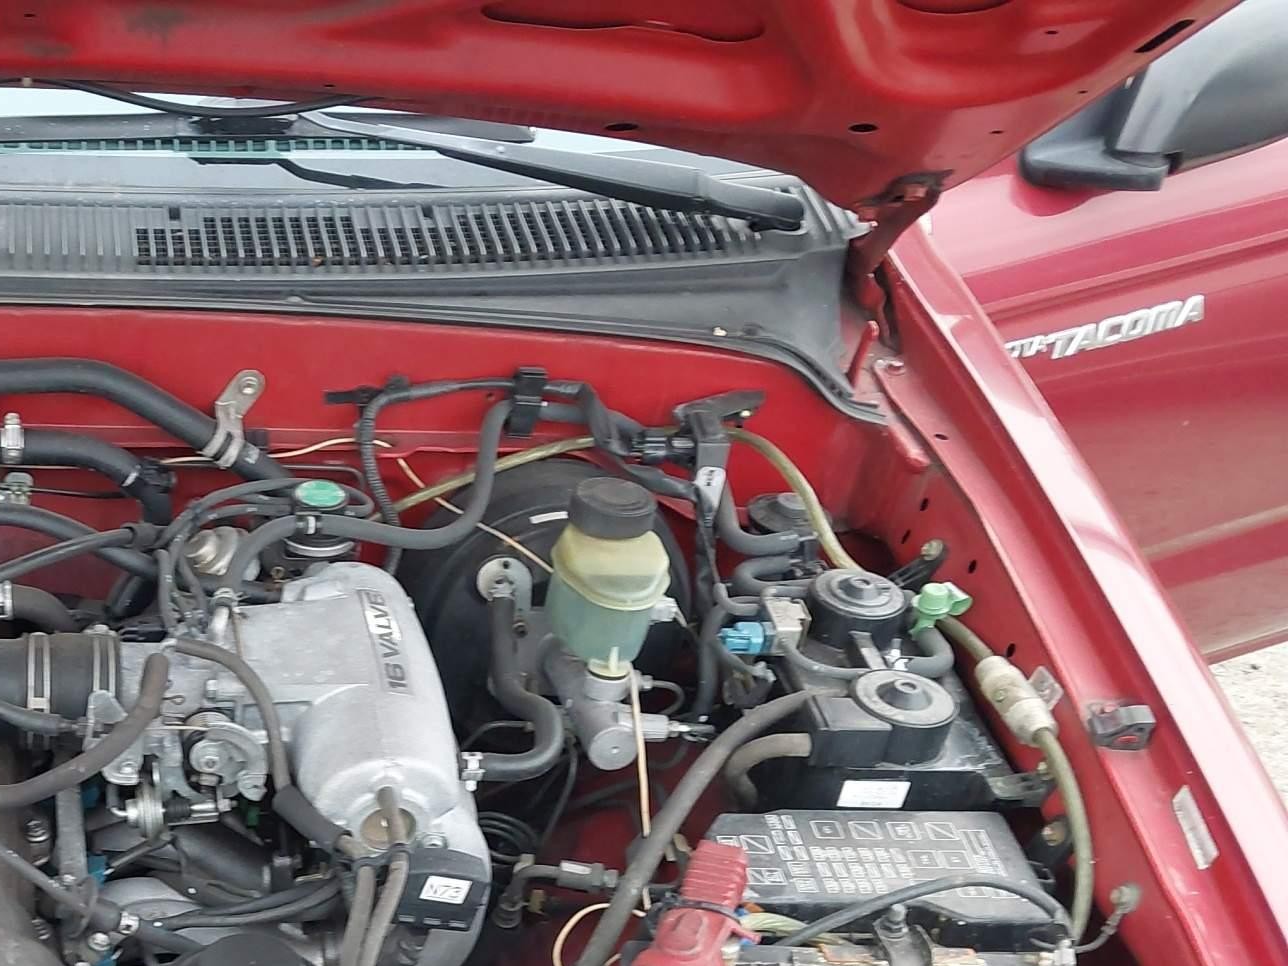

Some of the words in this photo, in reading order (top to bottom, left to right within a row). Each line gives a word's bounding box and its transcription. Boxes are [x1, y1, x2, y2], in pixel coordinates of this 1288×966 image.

[1046, 295, 1205, 359] TACOMA
[365, 590, 400, 658] VALVE
[384, 662, 408, 688] 16
